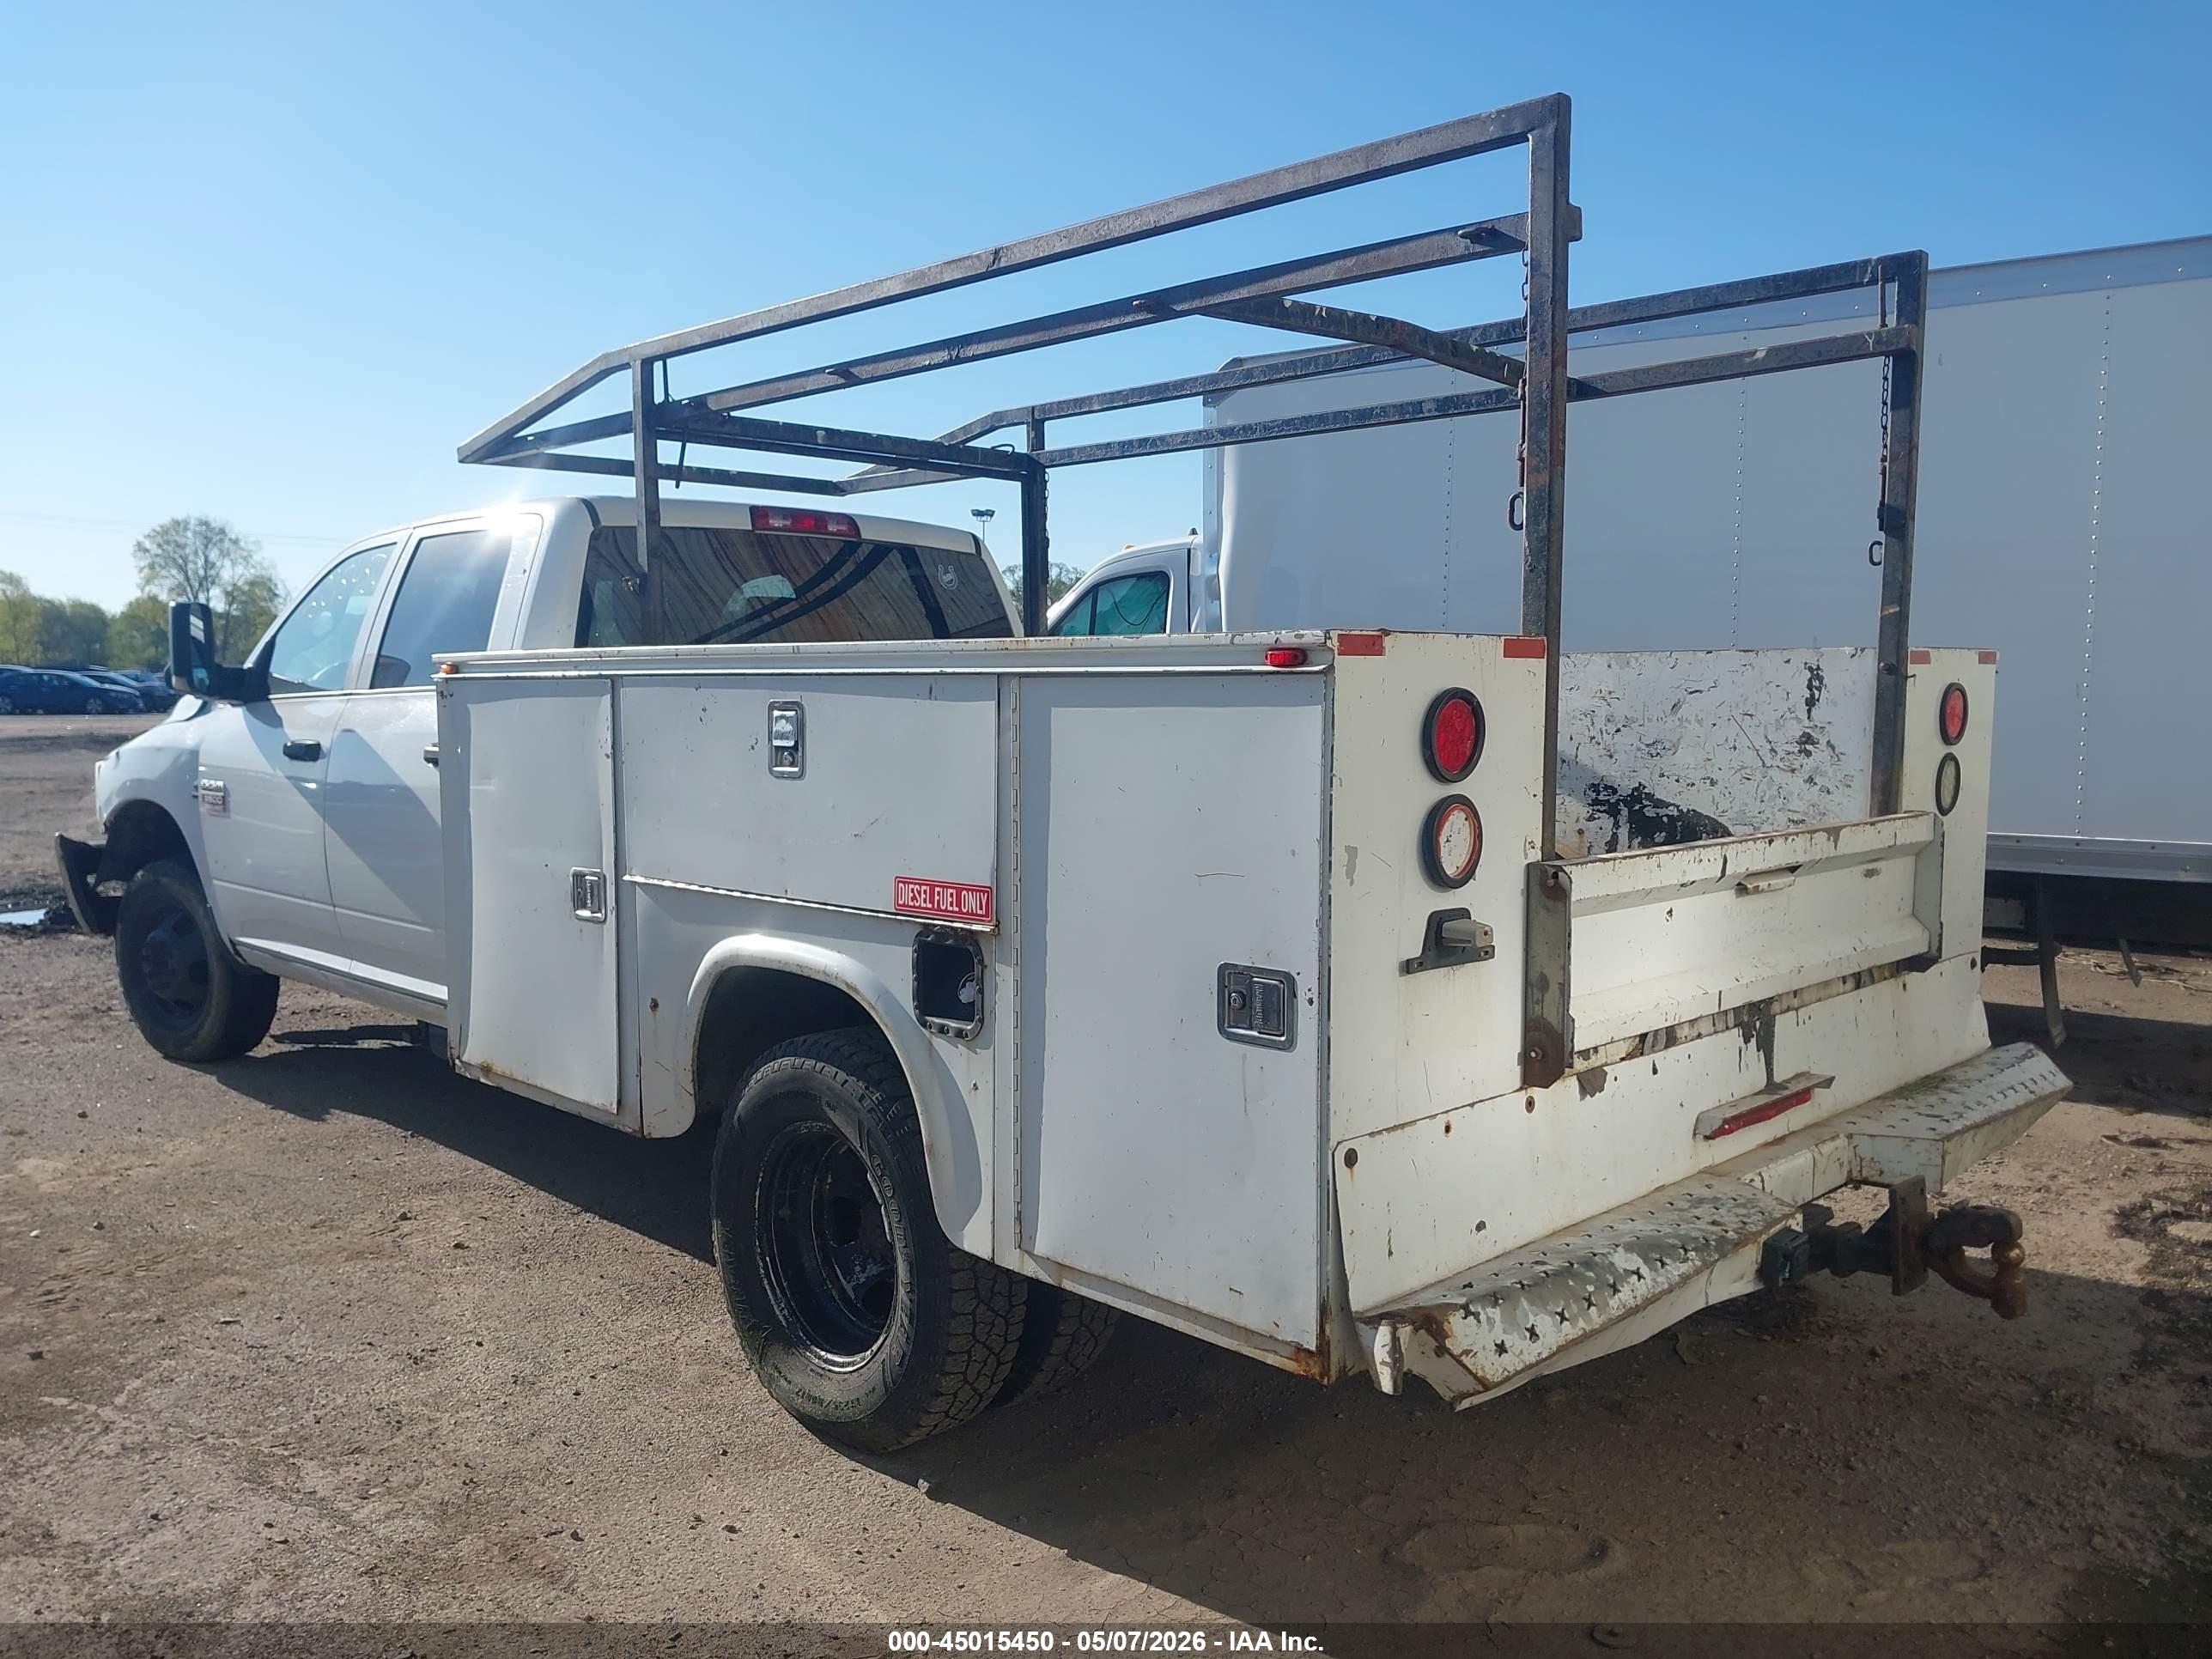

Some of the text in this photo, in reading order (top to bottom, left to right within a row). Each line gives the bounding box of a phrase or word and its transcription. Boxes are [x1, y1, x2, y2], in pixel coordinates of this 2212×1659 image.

[898, 883, 988, 915] DIESEL FUEL ONLY
